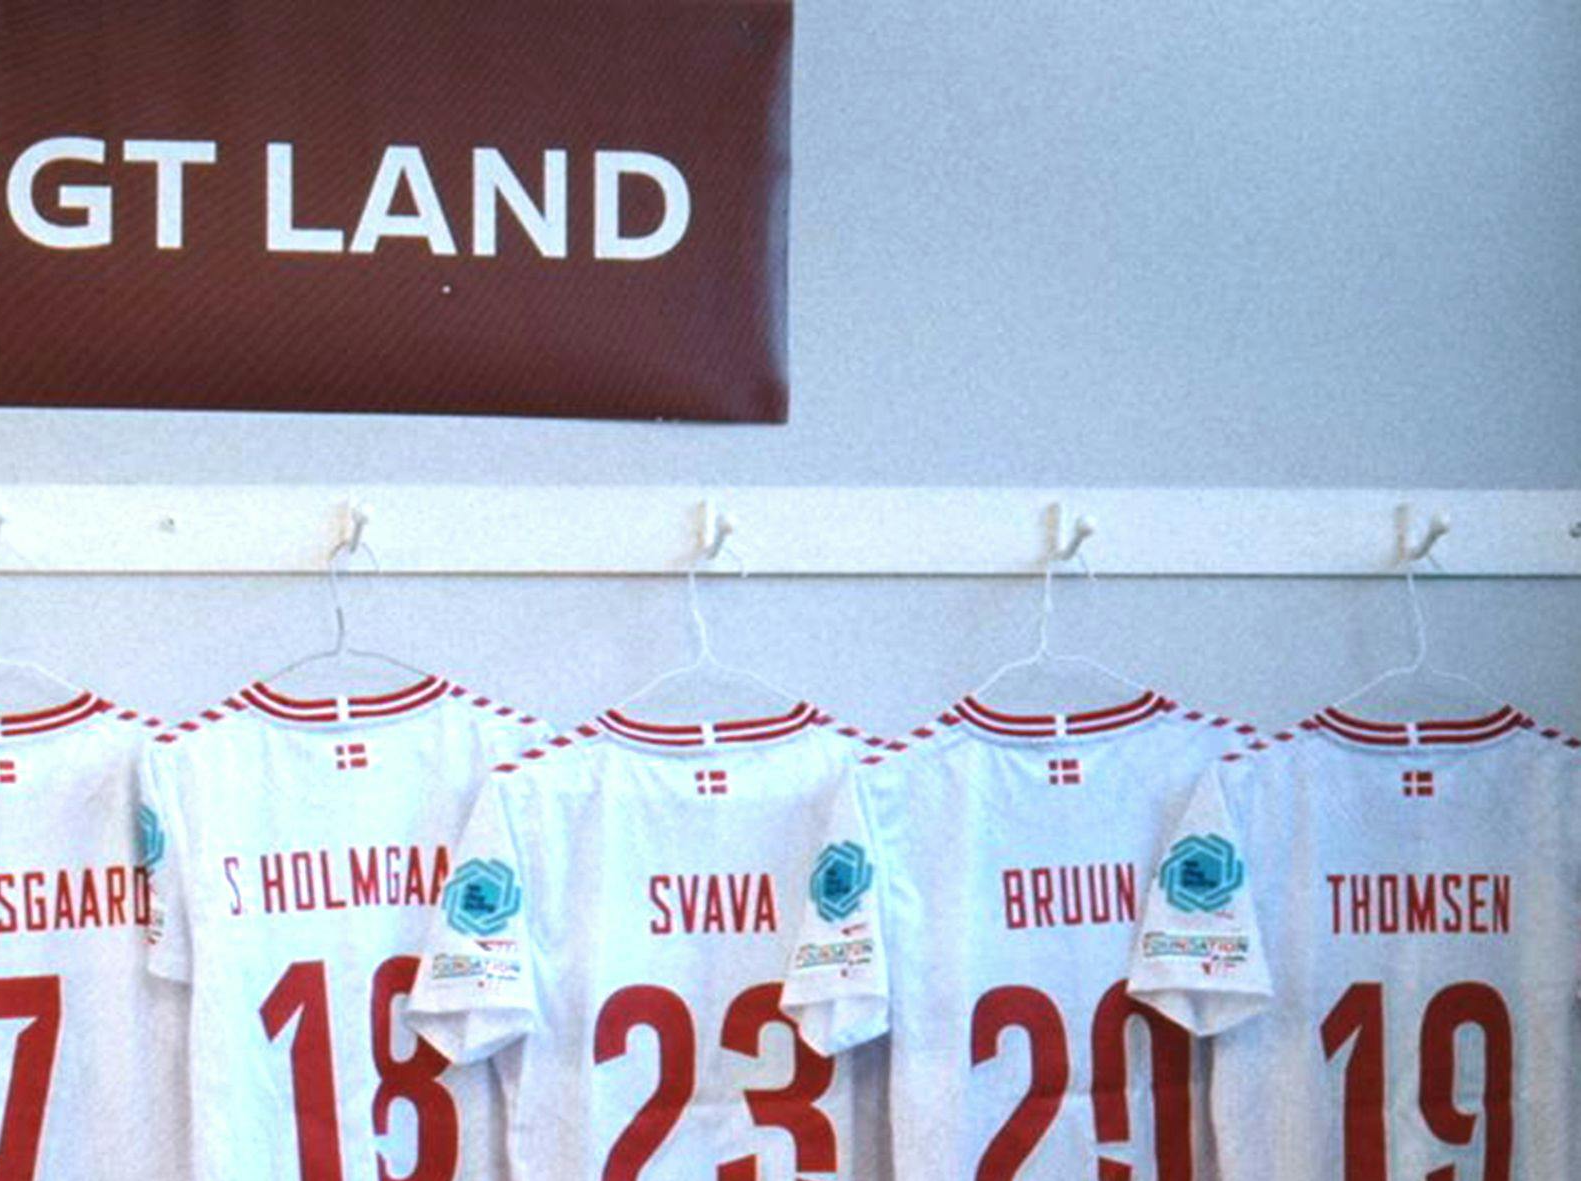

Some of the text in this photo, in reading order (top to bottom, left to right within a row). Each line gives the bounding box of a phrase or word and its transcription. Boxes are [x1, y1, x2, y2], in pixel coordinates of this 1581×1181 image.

[265, 142, 693, 262] LAND
[223, 856, 243, 915] S
[649, 872, 777, 935] SVAVA
[1002, 862, 1137, 930] BRUUN
[1326, 873, 1511, 935] THOMSEN
